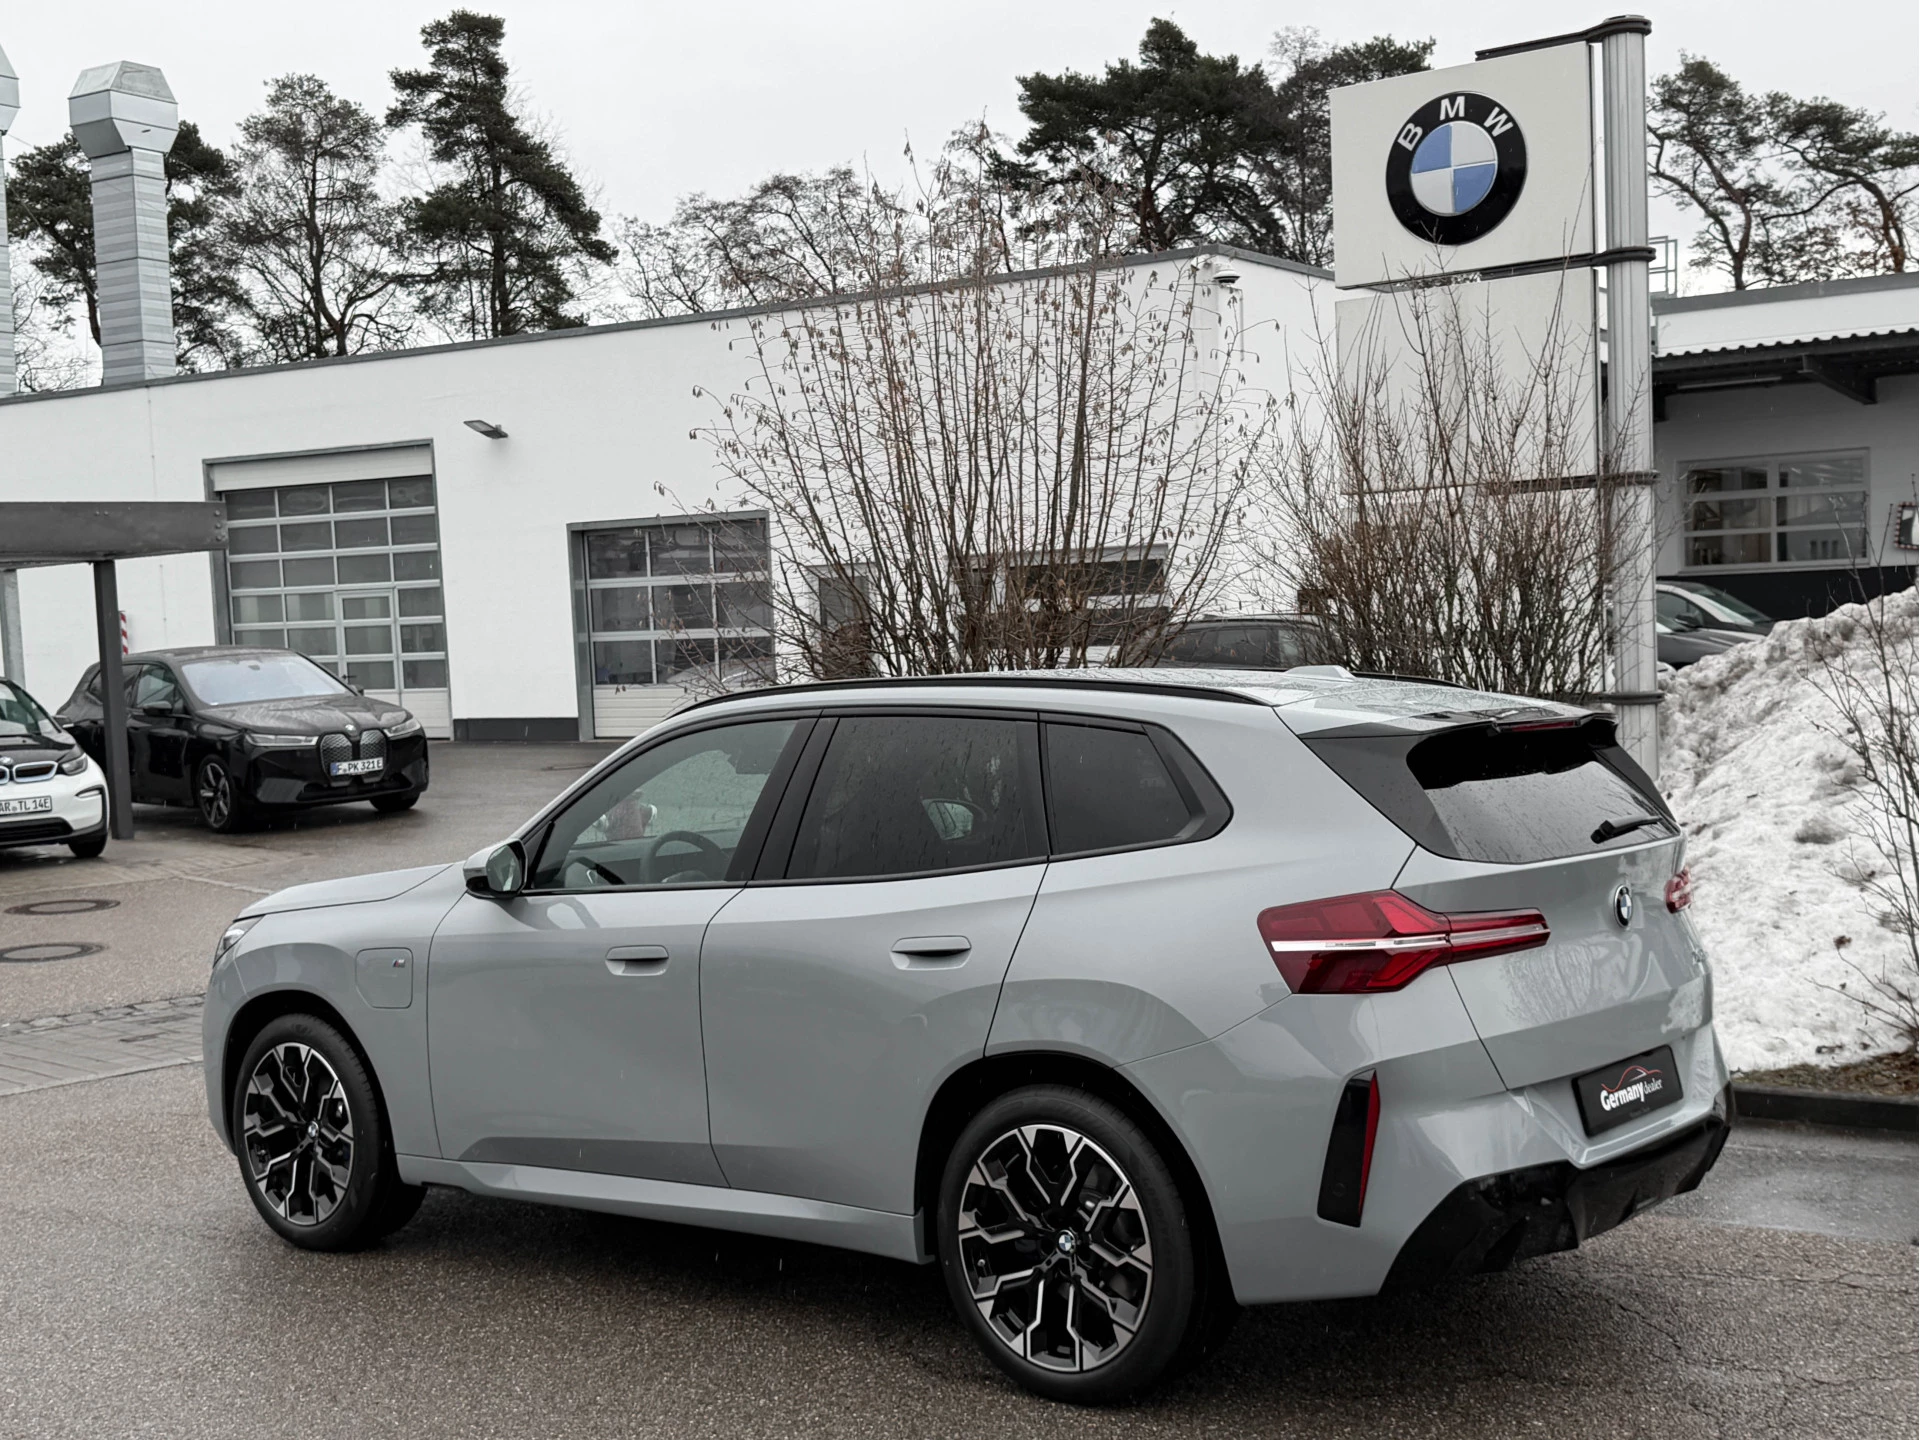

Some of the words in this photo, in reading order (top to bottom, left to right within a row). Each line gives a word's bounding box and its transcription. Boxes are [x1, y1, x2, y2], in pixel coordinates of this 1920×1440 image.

[1397, 95, 1514, 152] BMW
[348, 762, 359, 772] PK
[18, 799, 31, 811] TL
